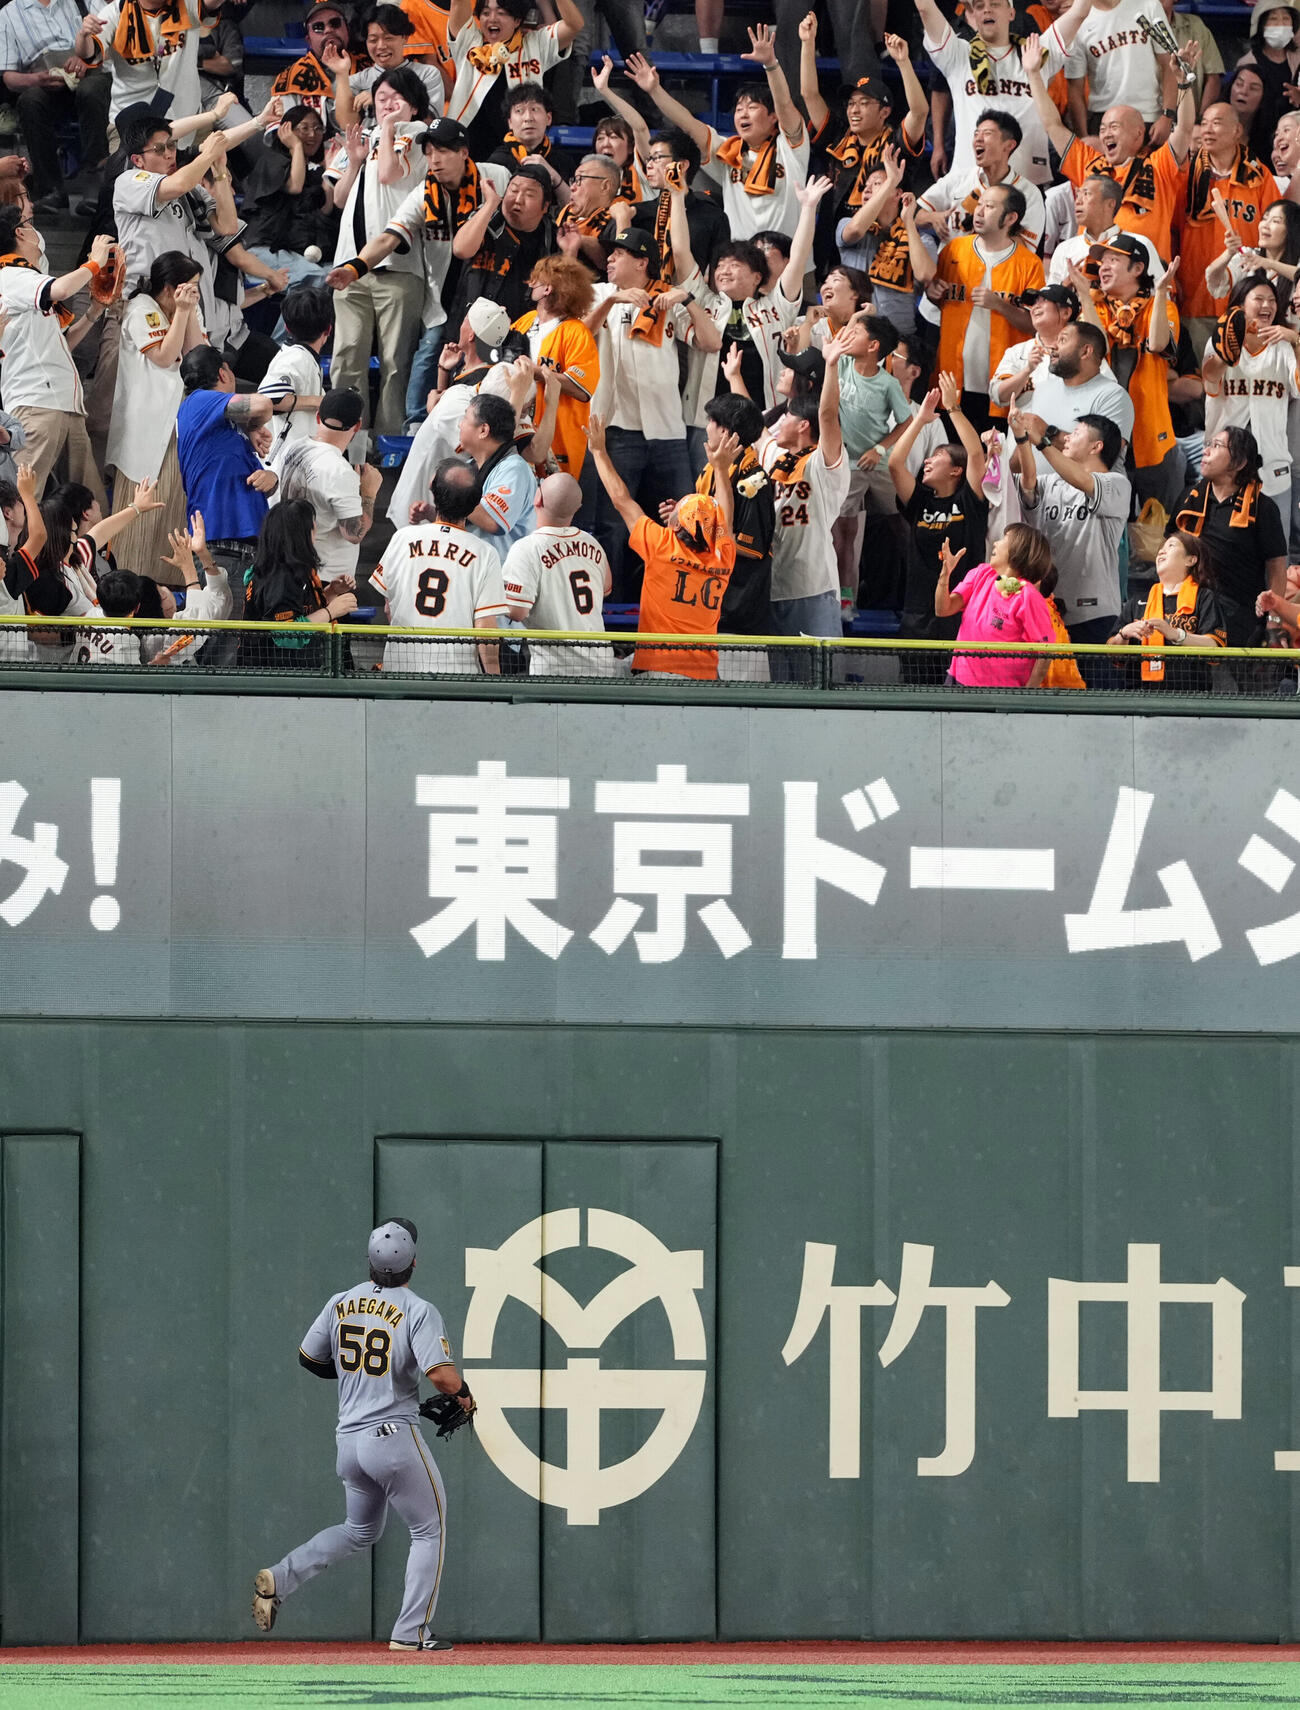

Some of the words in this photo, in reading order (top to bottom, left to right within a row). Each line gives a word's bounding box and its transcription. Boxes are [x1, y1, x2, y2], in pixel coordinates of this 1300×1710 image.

[1089, 29, 1149, 58] GIANTS
[507, 58, 541, 79] NTS
[965, 79, 1033, 97] GANTS
[387, 453, 396, 466] 5
[781, 503, 809, 527] 24
[408, 540, 477, 568] MARU
[541, 540, 602, 569] SAKAMOTO
[415, 567, 450, 618] 8
[568, 569, 594, 615] 6
[671, 569, 722, 610] LG
[336, 1297, 404, 1329] MAEGAWA
[339, 1322, 392, 1377] 58
[781, 1241, 1300, 1483] 竹中
